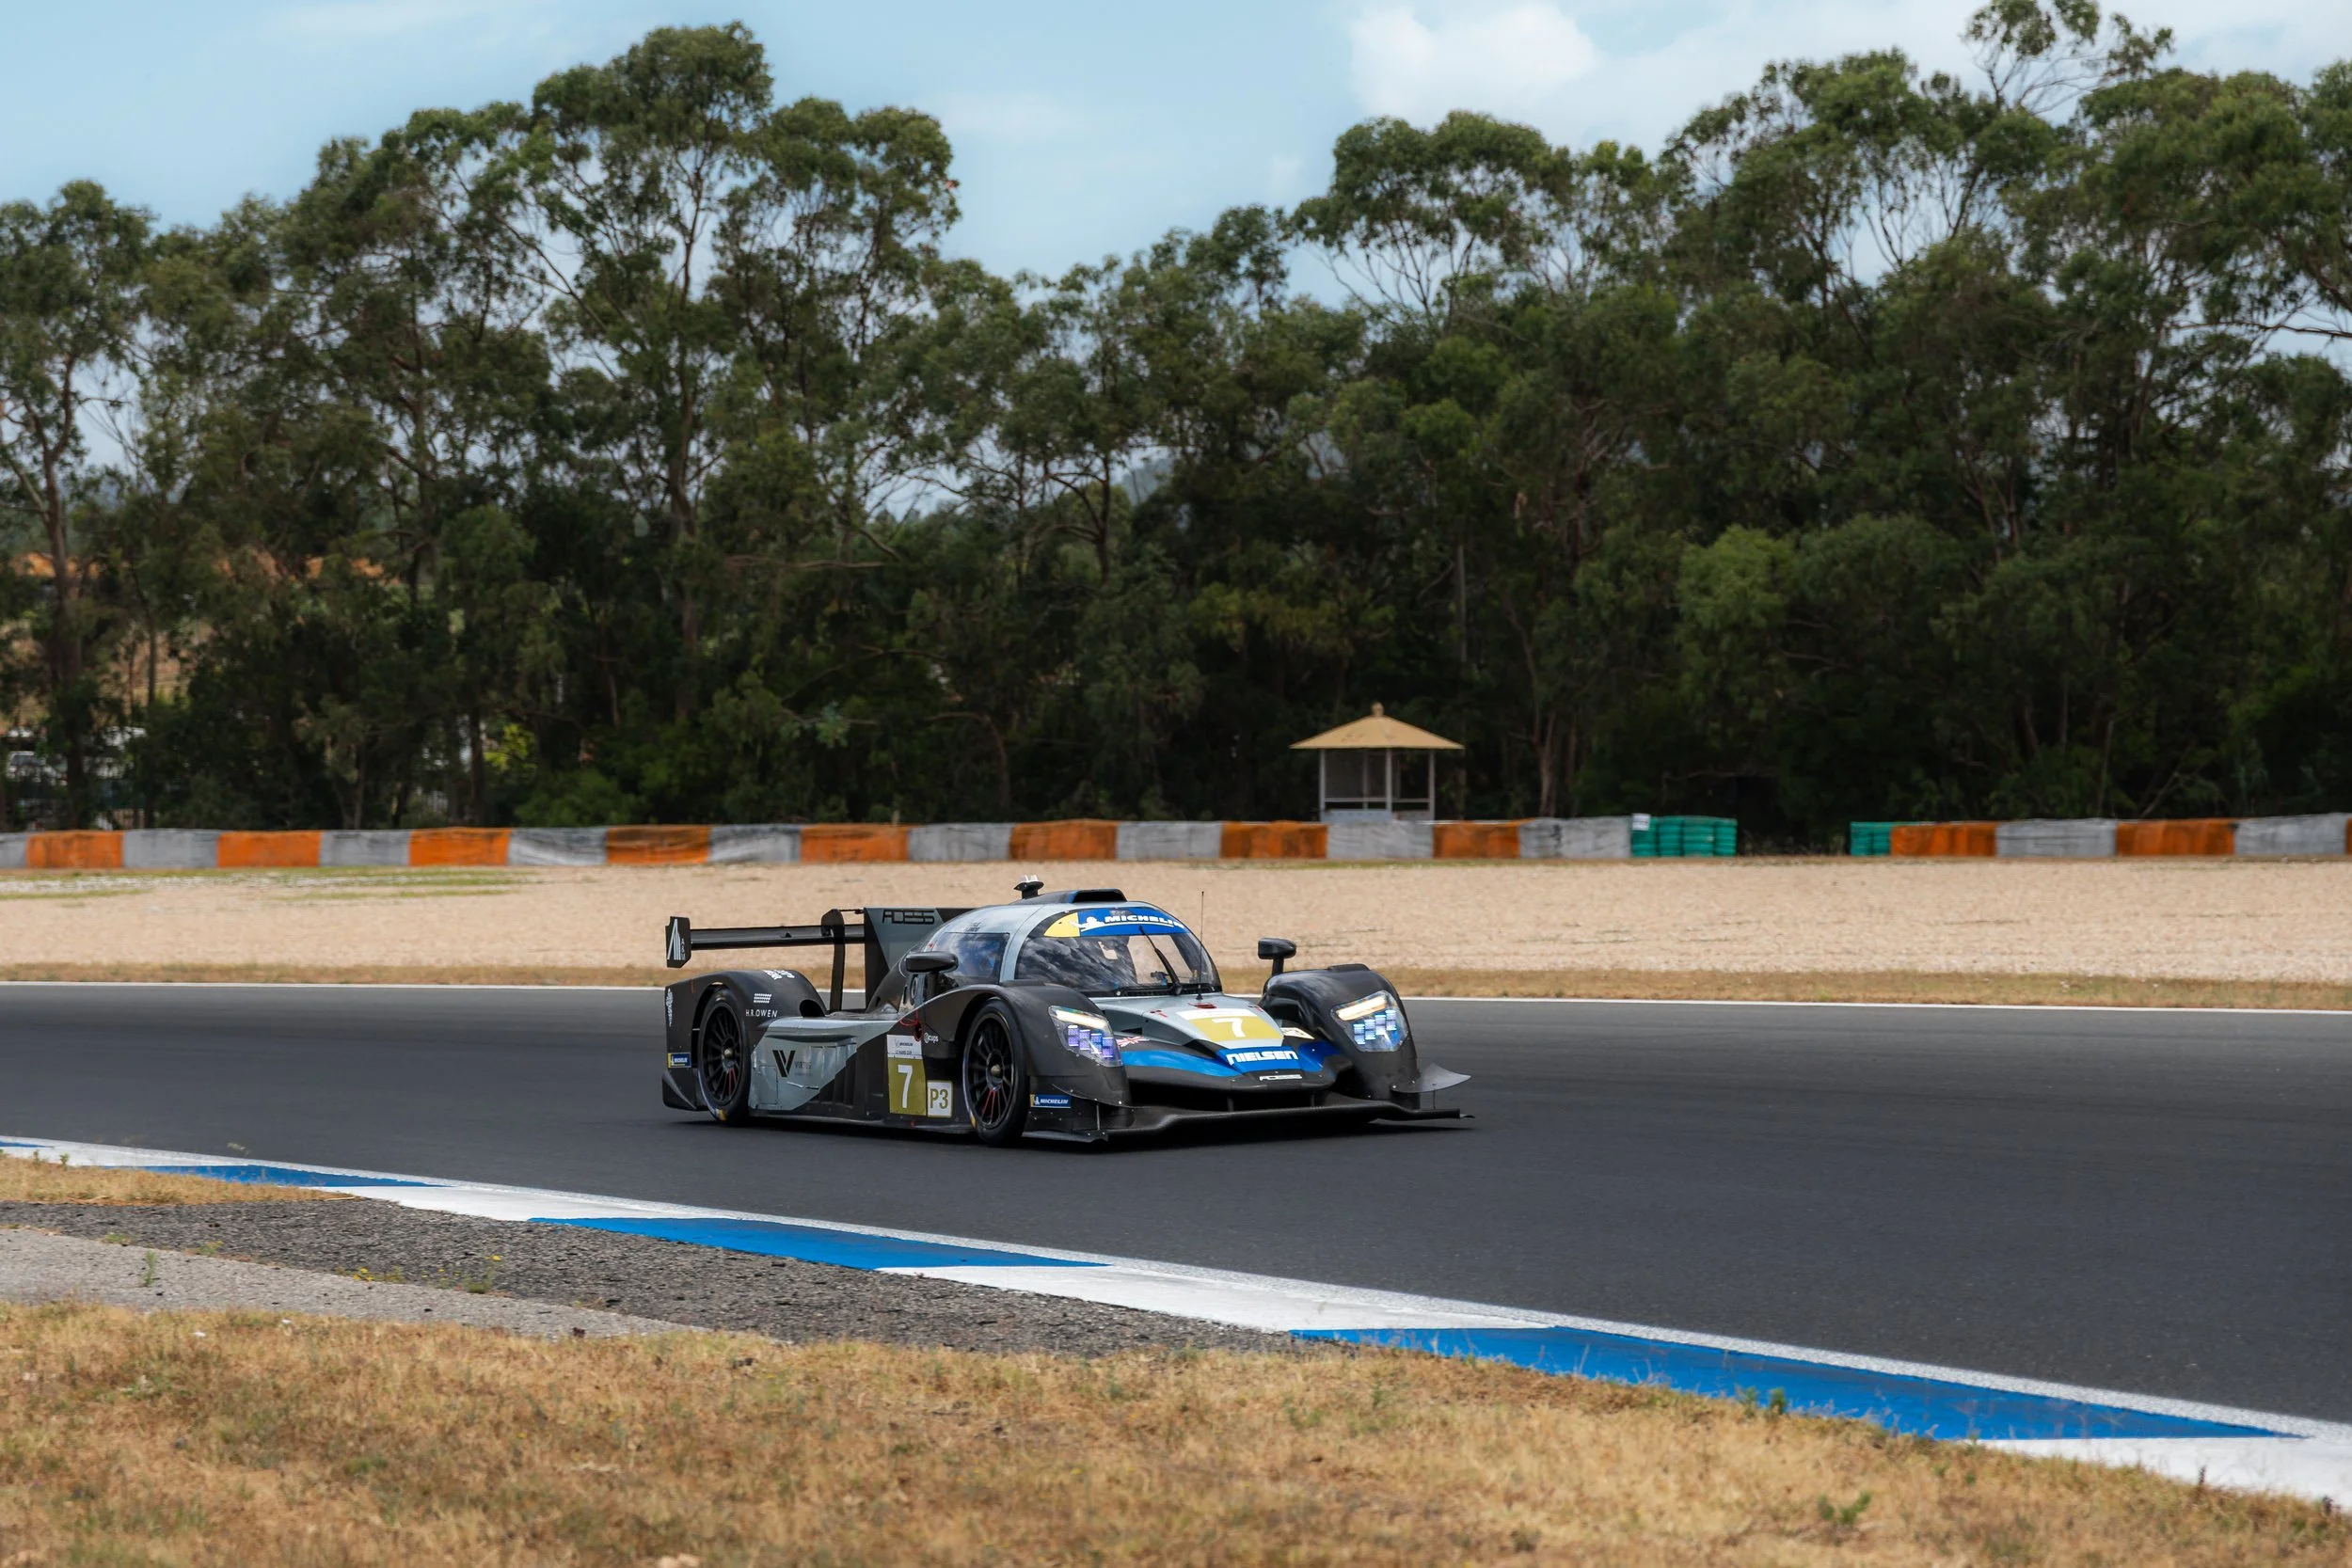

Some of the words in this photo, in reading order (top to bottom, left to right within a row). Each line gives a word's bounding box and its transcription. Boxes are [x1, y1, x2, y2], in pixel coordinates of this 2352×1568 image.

[1104, 915, 1184, 928] MICHELIN
[1212, 1017, 1247, 1037] 7
[1226, 1050, 1298, 1066] NIELSEN
[898, 1065, 914, 1109] 7
[930, 1088, 948, 1109] P3
